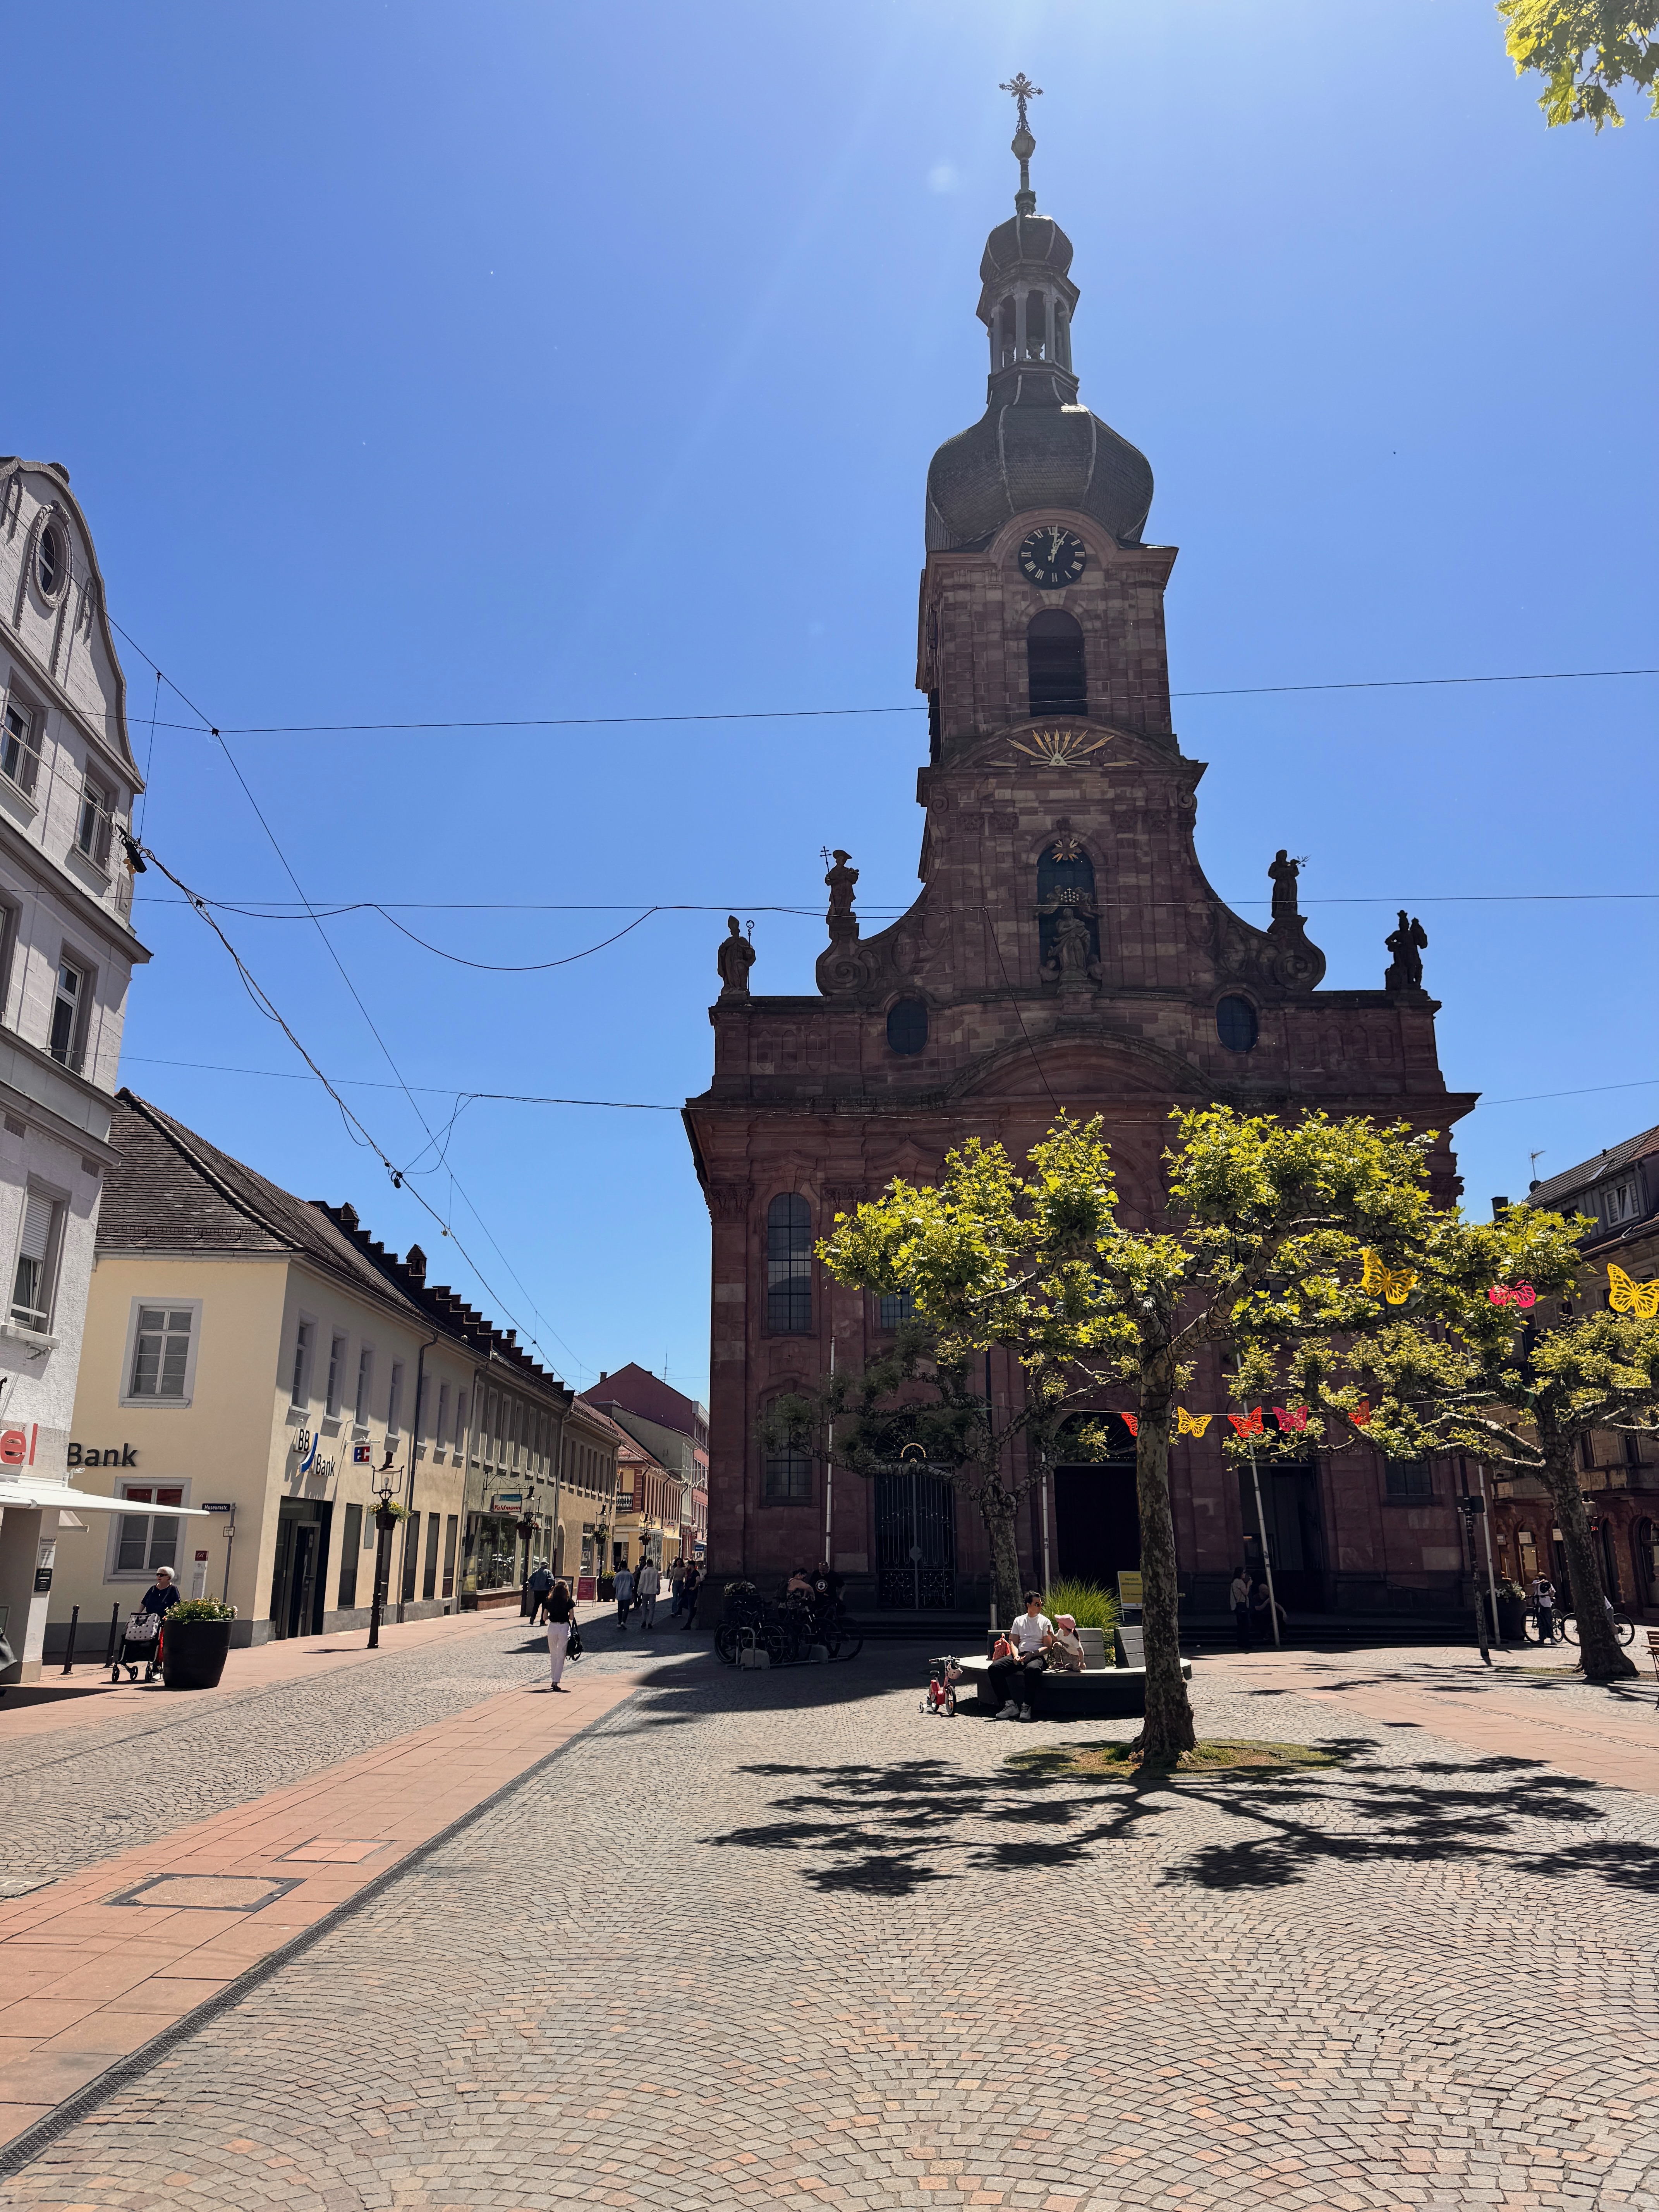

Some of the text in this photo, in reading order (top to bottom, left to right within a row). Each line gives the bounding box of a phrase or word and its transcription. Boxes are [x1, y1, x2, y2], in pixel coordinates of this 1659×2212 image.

[298, 1429, 310, 1451] BB
[67, 1443, 138, 1467] Bank
[316, 1453, 335, 1476] Bank
